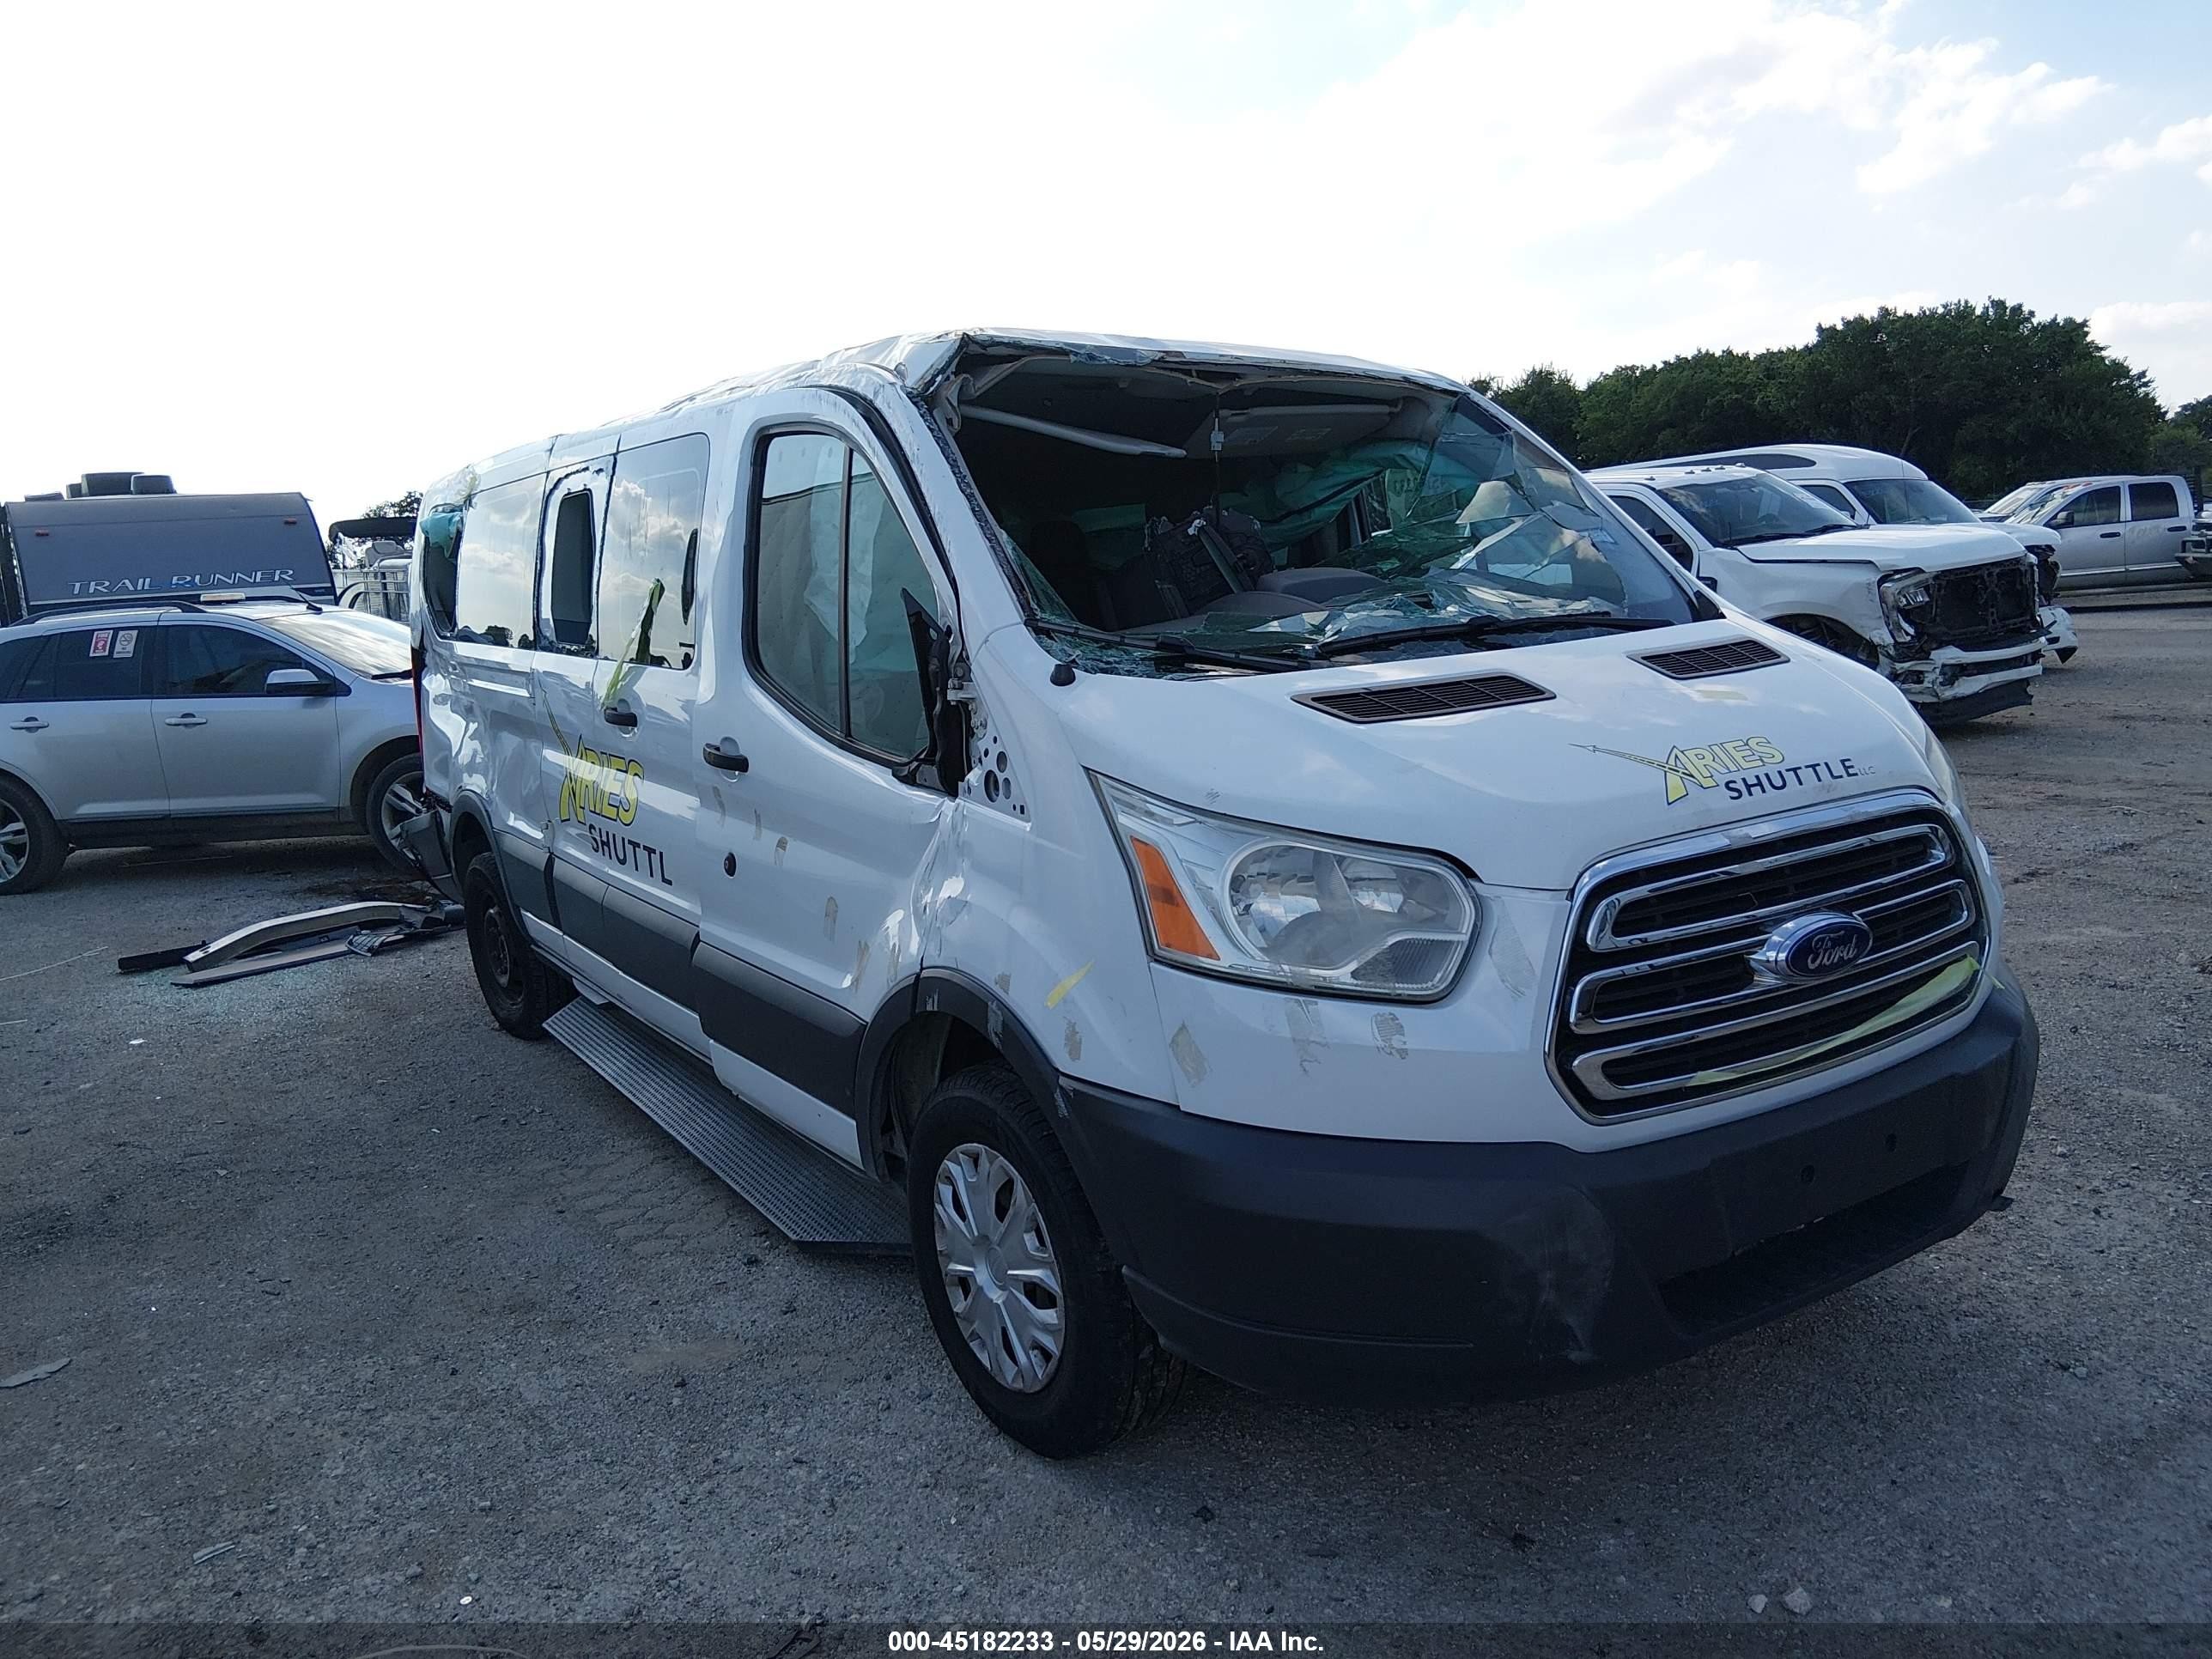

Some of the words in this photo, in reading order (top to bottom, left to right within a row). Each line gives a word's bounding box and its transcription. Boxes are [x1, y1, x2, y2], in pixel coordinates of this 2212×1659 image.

[68, 577, 161, 595] TRAIL
[171, 568, 295, 588] RUNNER
[559, 733, 645, 827] ARIES
[1664, 736, 1785, 805] ARIES
[1723, 757, 1859, 800] SHUTTLE
[588, 823, 673, 886] SHUTTL
[1807, 930, 1858, 969] Ford
